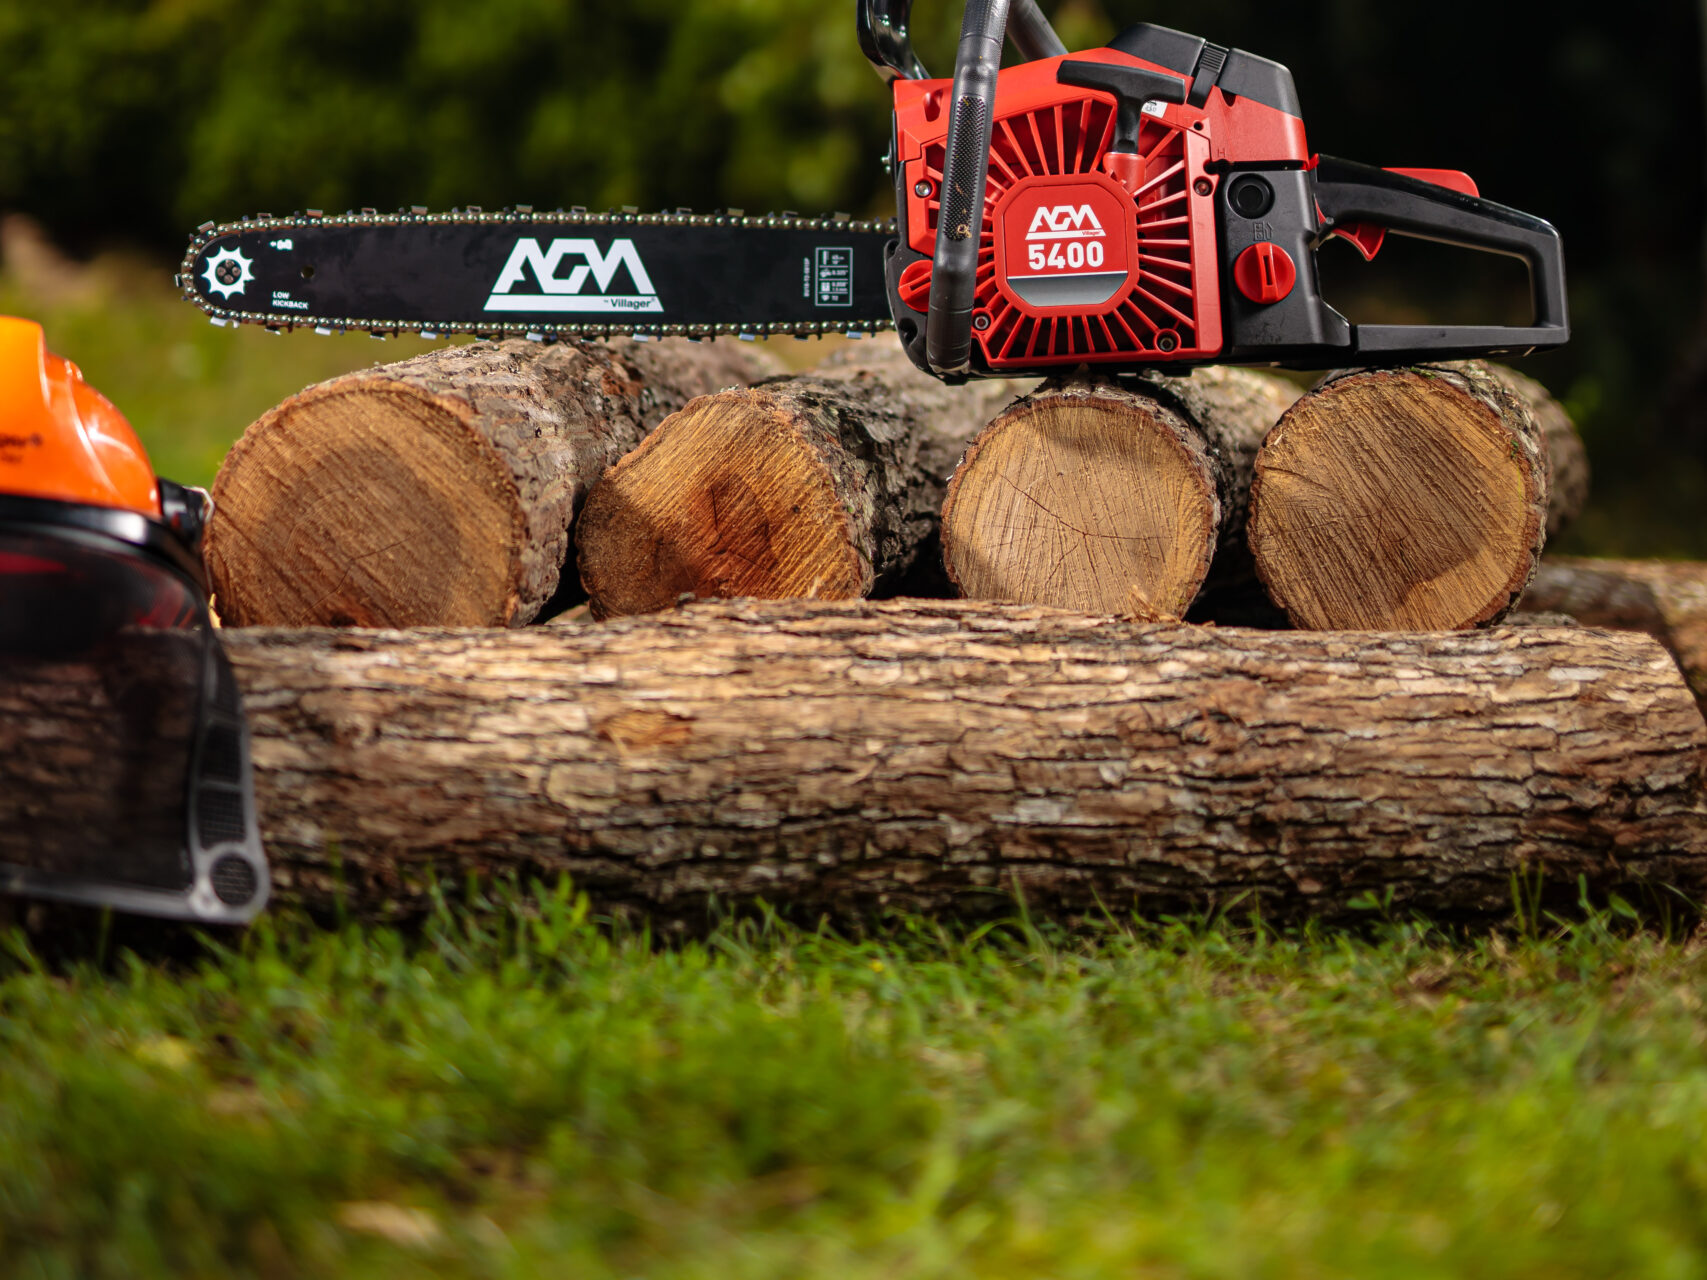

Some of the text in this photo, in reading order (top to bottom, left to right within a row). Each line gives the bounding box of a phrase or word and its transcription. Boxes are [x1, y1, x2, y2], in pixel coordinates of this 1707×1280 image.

[1027, 204, 1103, 233] AGM
[1028, 241, 1104, 270] 5400
[491, 238, 657, 295] AGM
[272, 291, 290, 300] LOW
[272, 299, 309, 310] KICKBACK
[610, 298, 652, 310] Villager
